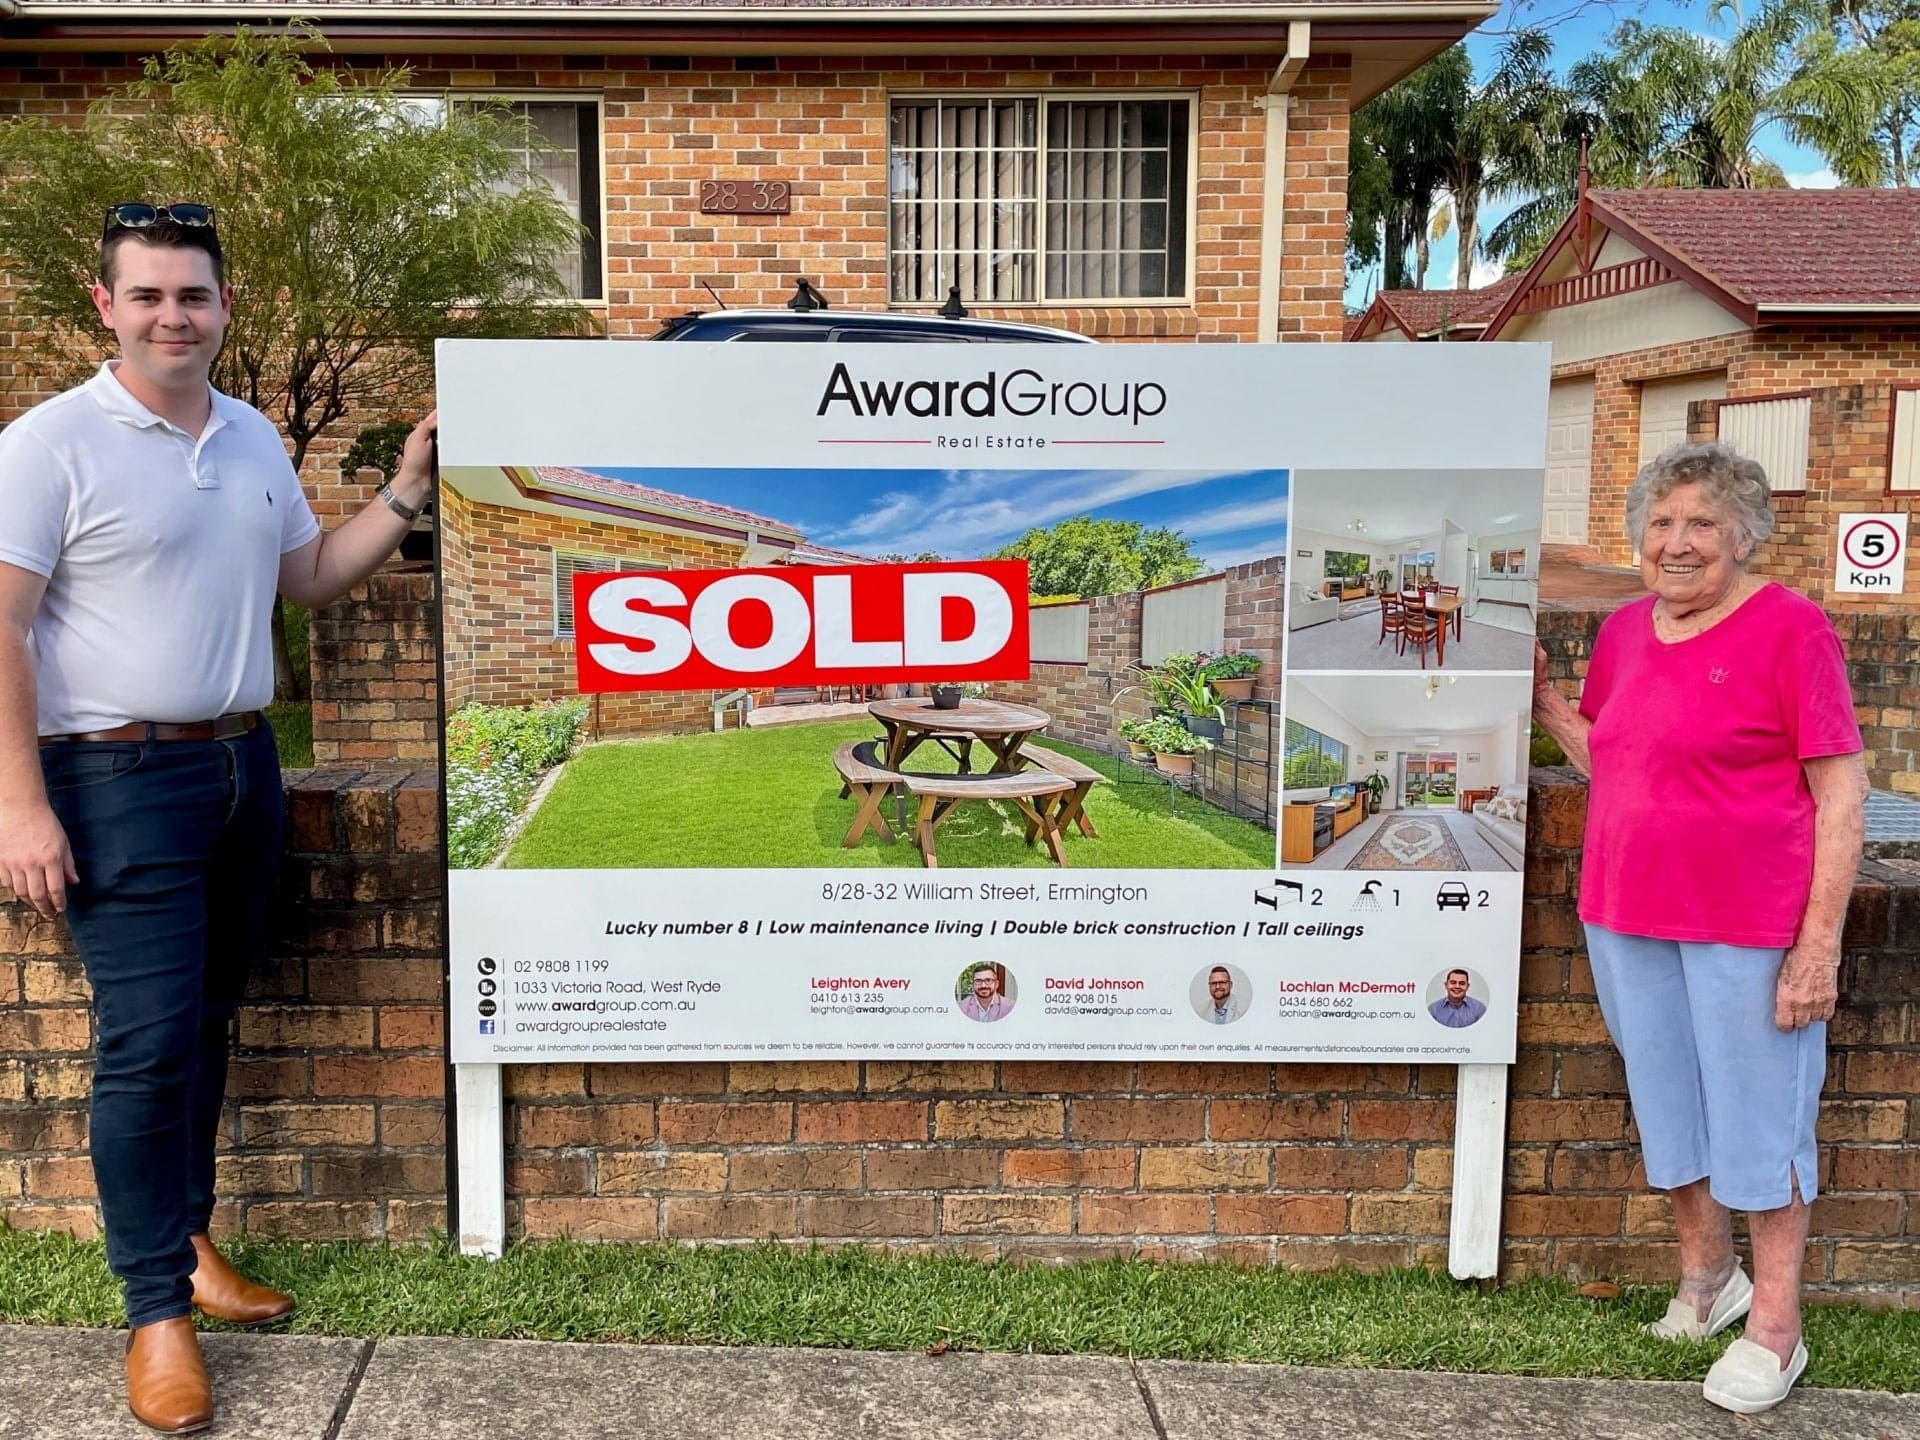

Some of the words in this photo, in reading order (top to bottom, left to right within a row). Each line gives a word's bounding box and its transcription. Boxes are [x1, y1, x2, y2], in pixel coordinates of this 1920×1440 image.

[702, 181, 788, 211] 28-32
[816, 362, 1168, 426] AwardGroup
[937, 435, 979, 449] Real
[986, 435, 1046, 449] Estate
[1861, 534, 1885, 558] 5
[1850, 571, 1891, 588] Kph
[587, 572, 1014, 676] SOLD
[821, 882, 898, 902] 8/28-32
[903, 882, 973, 901] William
[979, 882, 1040, 903] Street,
[1048, 883, 1148, 906] Ermington
[1310, 887, 1324, 906] 2
[1392, 888, 1400, 907] 1
[1476, 889, 1490, 908] 2
[604, 920, 659, 938] Lucky
[662, 920, 735, 936] number
[737, 920, 750, 935] 8
[768, 920, 806, 935] Low
[809, 919, 930, 935] maintenance
[934, 920, 984, 938] living
[1002, 920, 1069, 935] Double
[1072, 920, 1121, 935] brick
[1124, 920, 1237, 936] construction
[1256, 921, 1290, 937] Tall
[1293, 921, 1365, 941] ceilings
[513, 960, 532, 973] 02
[535, 960, 571, 973] 9808
[575, 960, 610, 973] 1199
[514, 981, 548, 994] 1033
[550, 980, 602, 994] Victoria
[605, 980, 647, 996] Road,
[651, 980, 684, 993] West
[686, 980, 722, 996] Ryde
[811, 976, 870, 991] Leighton
[873, 977, 911, 991] Avery
[1044, 977, 1085, 990] David
[1088, 977, 1145, 990] Johnson
[1338, 981, 1417, 994] McDermott
[811, 992, 839, 1003] 0410
[840, 992, 861, 1003] 613
[863, 993, 886, 1003] 235
[1044, 993, 1072, 1004] 0402
[1074, 993, 1095, 1004] 908
[1097, 993, 1118, 1004] 015
[1279, 996, 1307, 1008] 0434
[1309, 996, 1330, 1008] 680
[1332, 997, 1354, 1008] 662
[515, 999, 696, 1014] www.awardgroup.com.au
[811, 1005, 949, 1016] leighton@awardgroup.com.au
[1044, 1006, 1173, 1017] david@awardgroup.com.au
[515, 1018, 668, 1035] awardgrouprealestate
[592, 1043, 627, 1053] provided
[629, 1043, 643, 1052] has
[644, 1043, 665, 1051] been
[666, 1043, 703, 1054] gathered
[767, 1042, 792, 1051] deem
[802, 1042, 814, 1050] be
[896, 1042, 925, 1050] cannot
[926, 1042, 965, 1052] guarantee
[1014, 1042, 1031, 1050] and
[1032, 1043, 1046, 1052] any
[1087, 1044, 1117, 1052] persons
[1118, 1043, 1143, 1051] should
[1159, 1044, 1180, 1053] upon
[1406, 1046, 1420, 1054] are
